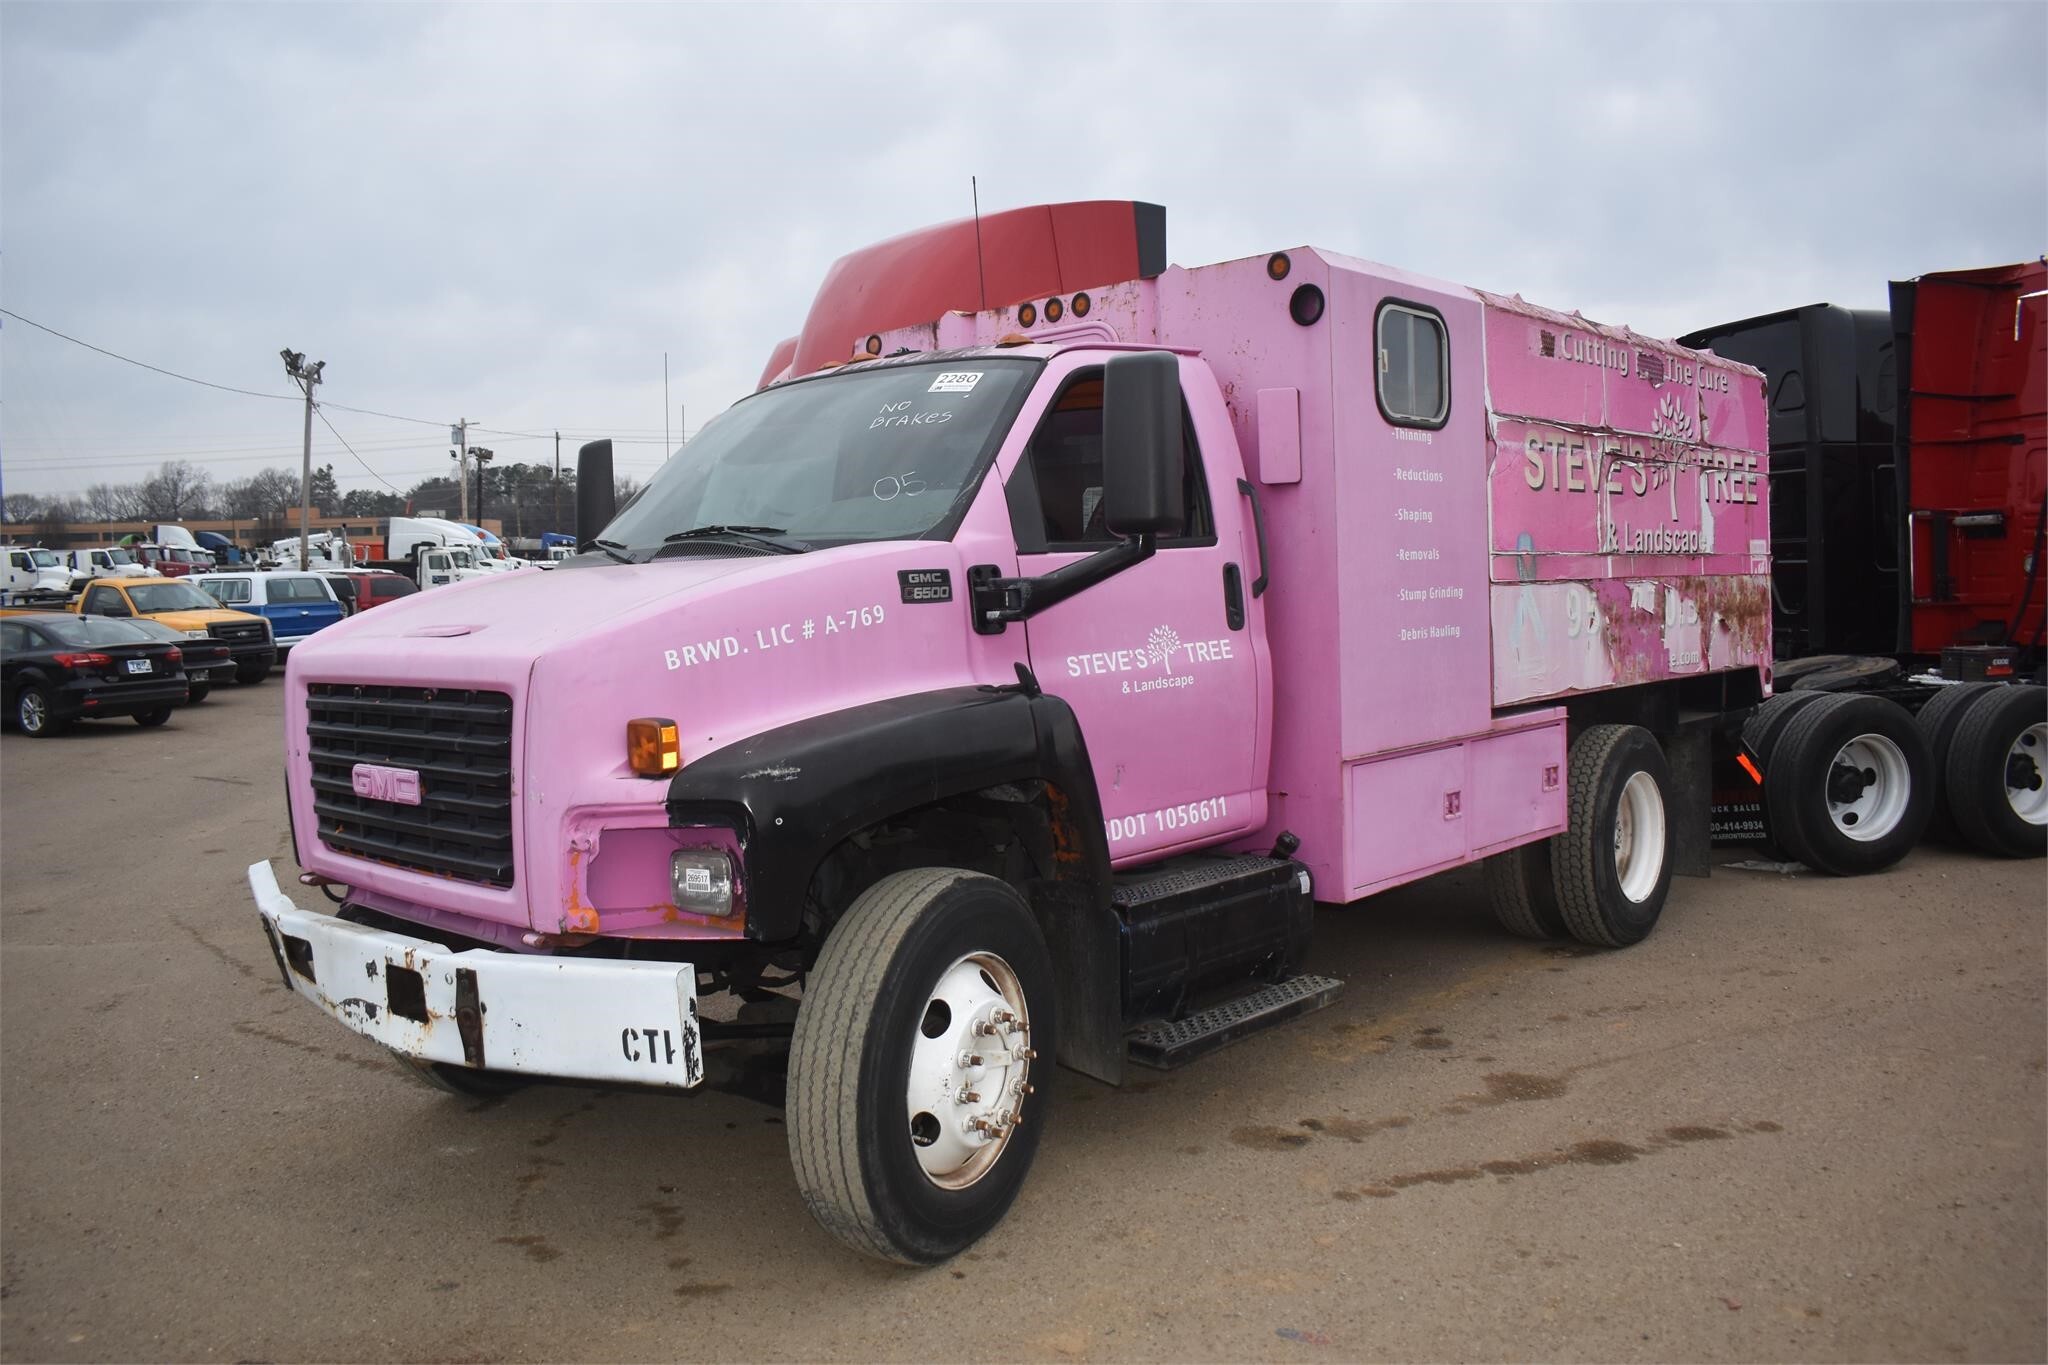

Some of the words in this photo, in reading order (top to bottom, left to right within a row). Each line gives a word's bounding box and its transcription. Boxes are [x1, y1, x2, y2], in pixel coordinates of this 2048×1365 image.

[1561, 332, 1629, 377] Cutting
[1665, 355, 1693, 385] The
[1697, 364, 1729, 393] Cure
[938, 374, 978, 383] 2280
[879, 400, 912, 414] NO
[1393, 467, 1443, 482] -Reductions
[1523, 430, 1648, 497] STEVE'S
[1698, 447, 1758, 504] TREE
[1394, 508, 1433, 523] -Shaping
[1396, 548, 1440, 561] -Removals
[908, 573, 942, 583] GMC
[1397, 588, 1427, 601] -Stump
[1429, 586, 1463, 600] Grinding
[664, 636, 749, 670] BRWD.
[756, 624, 795, 650] LIC
[802, 619, 815, 640] #
[825, 604, 885, 635] A-769
[1398, 628, 1428, 641] -Debris
[1430, 624, 1461, 640] Hauling
[1066, 648, 1149, 678] STEVE'S
[1183, 639, 1234, 663] TREE
[1122, 680, 1131, 694] &
[1134, 674, 1195, 693] Landscape
[353, 767, 417, 803] GMC
[1154, 796, 1228, 832] 1056611
[1733, 803, 1761, 812] SALES
